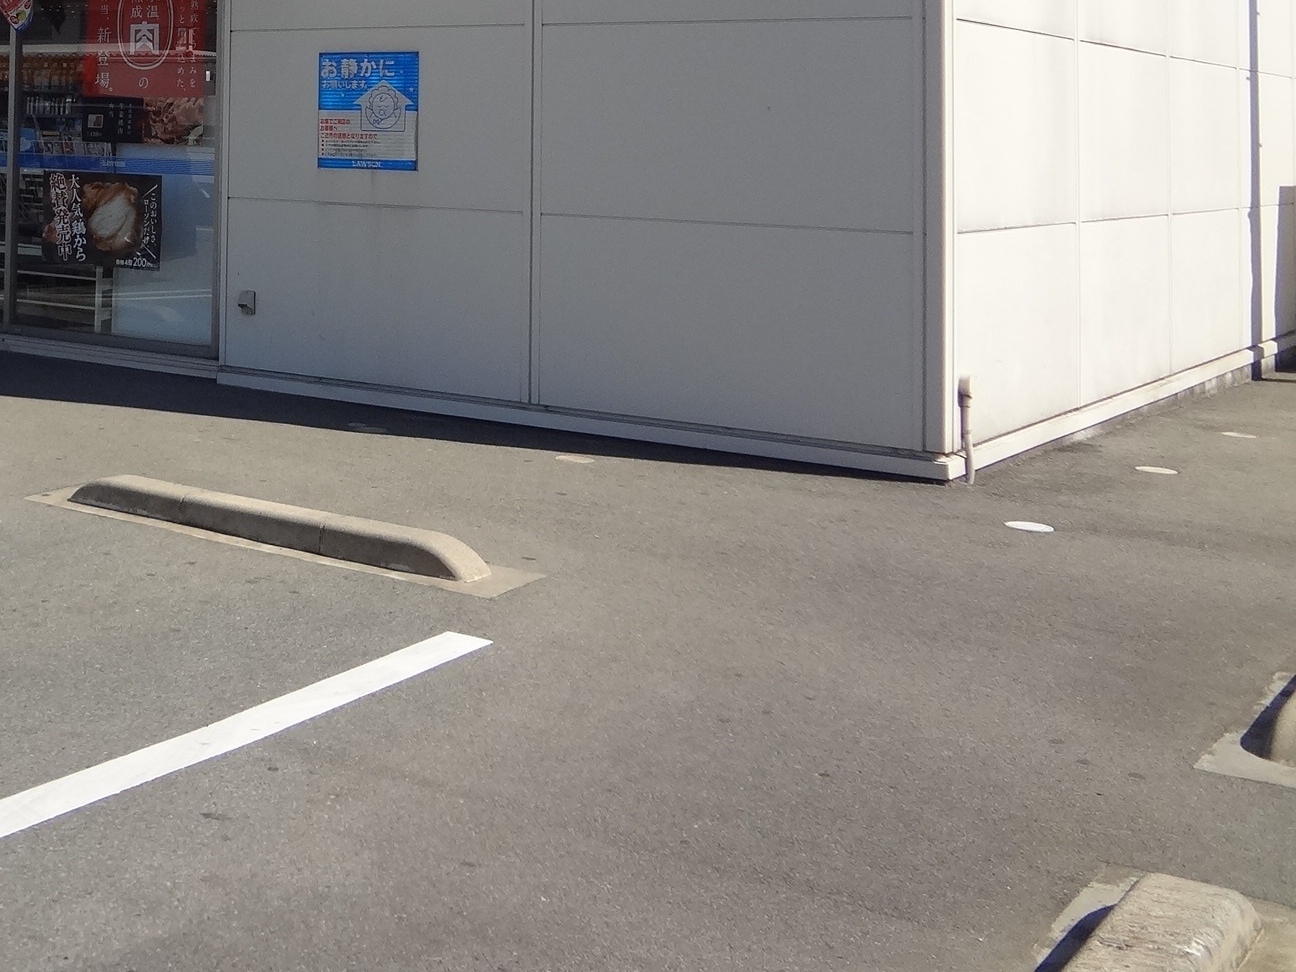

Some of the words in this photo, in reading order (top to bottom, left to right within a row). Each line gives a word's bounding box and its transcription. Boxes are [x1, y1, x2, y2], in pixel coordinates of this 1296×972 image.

[138, 77, 149, 89] の
[320, 58, 396, 79] お静かに
[49, 173, 72, 262] 絶賛発売中
[69, 173, 87, 262] 大人気鶏から
